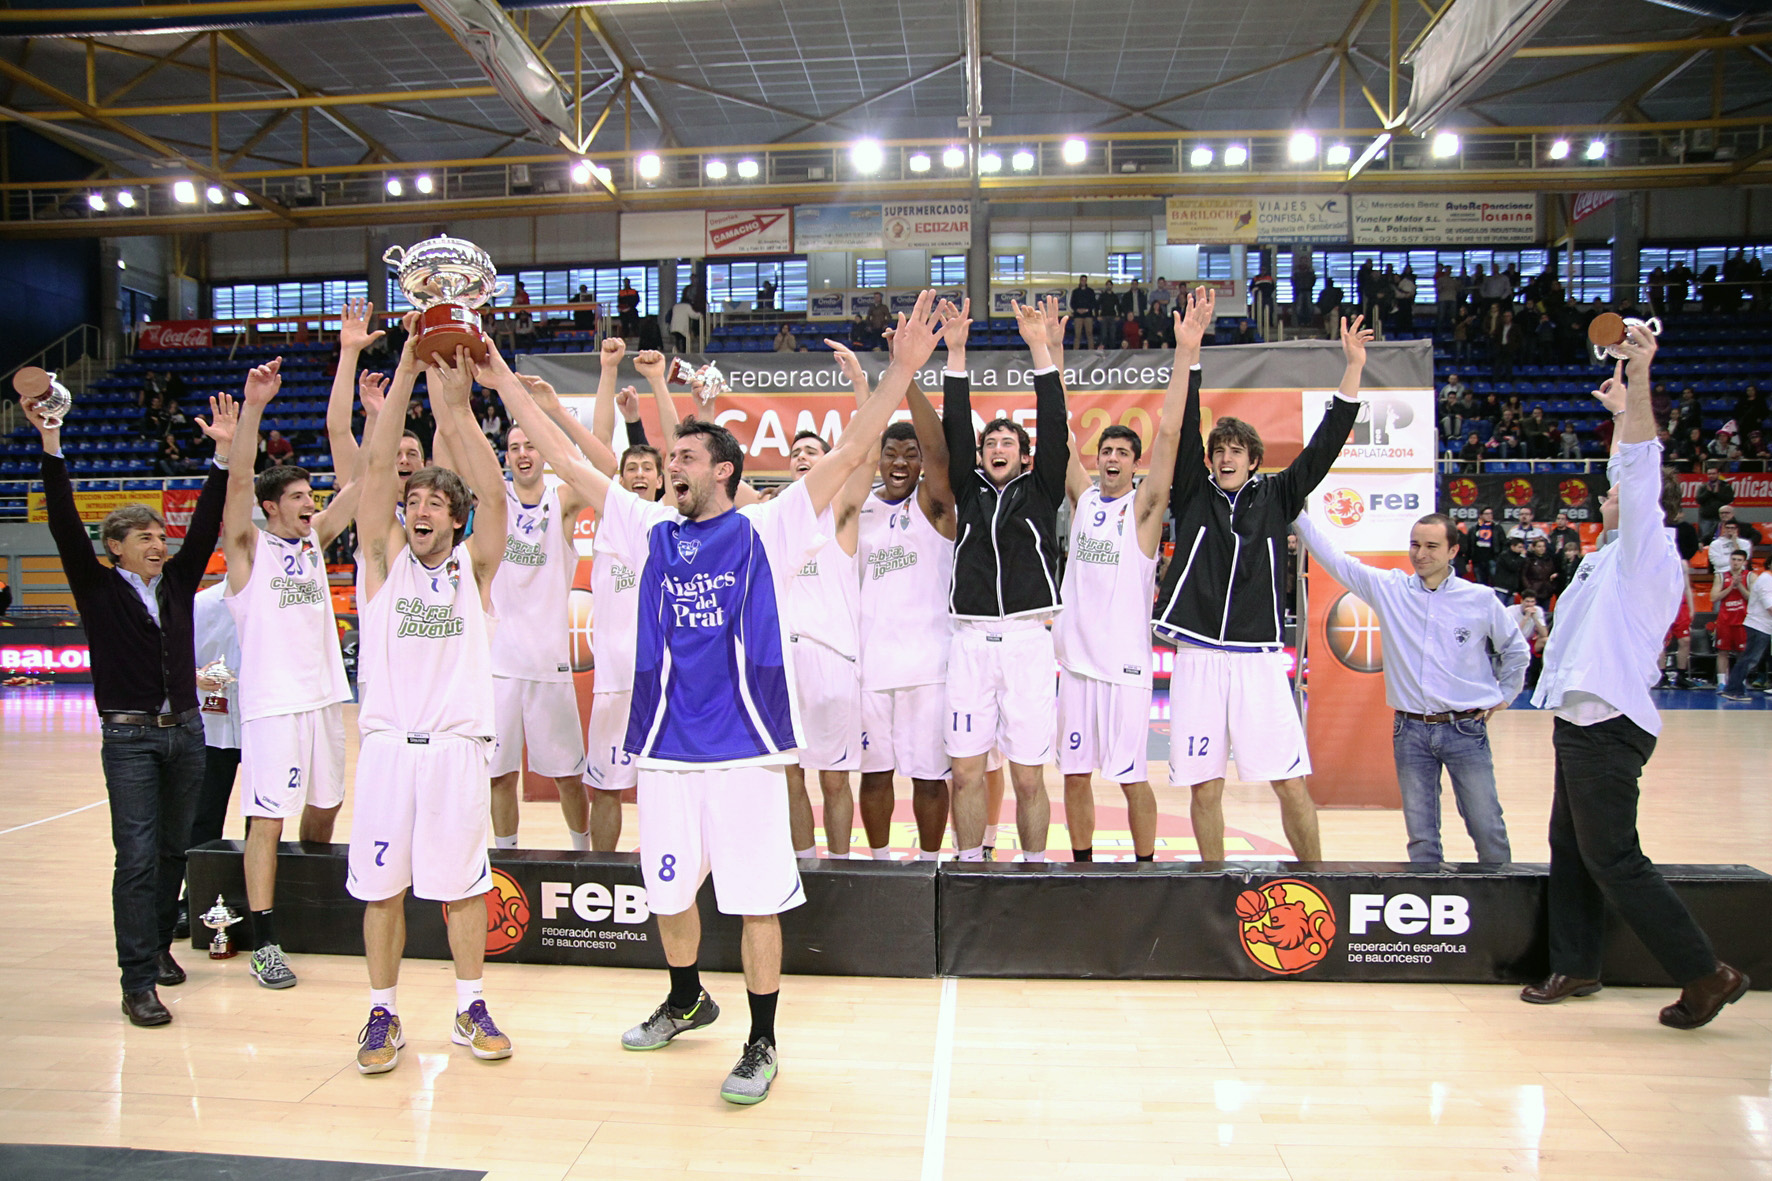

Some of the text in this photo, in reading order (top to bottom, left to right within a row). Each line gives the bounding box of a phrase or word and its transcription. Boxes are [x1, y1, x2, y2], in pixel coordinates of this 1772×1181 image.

[884, 204, 969, 217] SUPERMERCADOS
[1171, 209, 1240, 220] BARILOCHE
[1258, 201, 1307, 211] VIAJES
[713, 220, 760, 243] CAMACHO
[914, 221, 969, 234] ECOZAR
[1386, 225, 1424, 233] Polaina
[1093, 510, 1107, 527] 9
[1504, 507, 1521, 519] Fe
[695, 592, 718, 611] del
[671, 603, 725, 628] Prat
[952, 711, 972, 733] 11
[1069, 731, 1082, 750] 9
[1188, 735, 1210, 757] 12
[611, 746, 632, 766] 13
[374, 840, 390, 867] 7
[658, 853, 677, 882] 8
